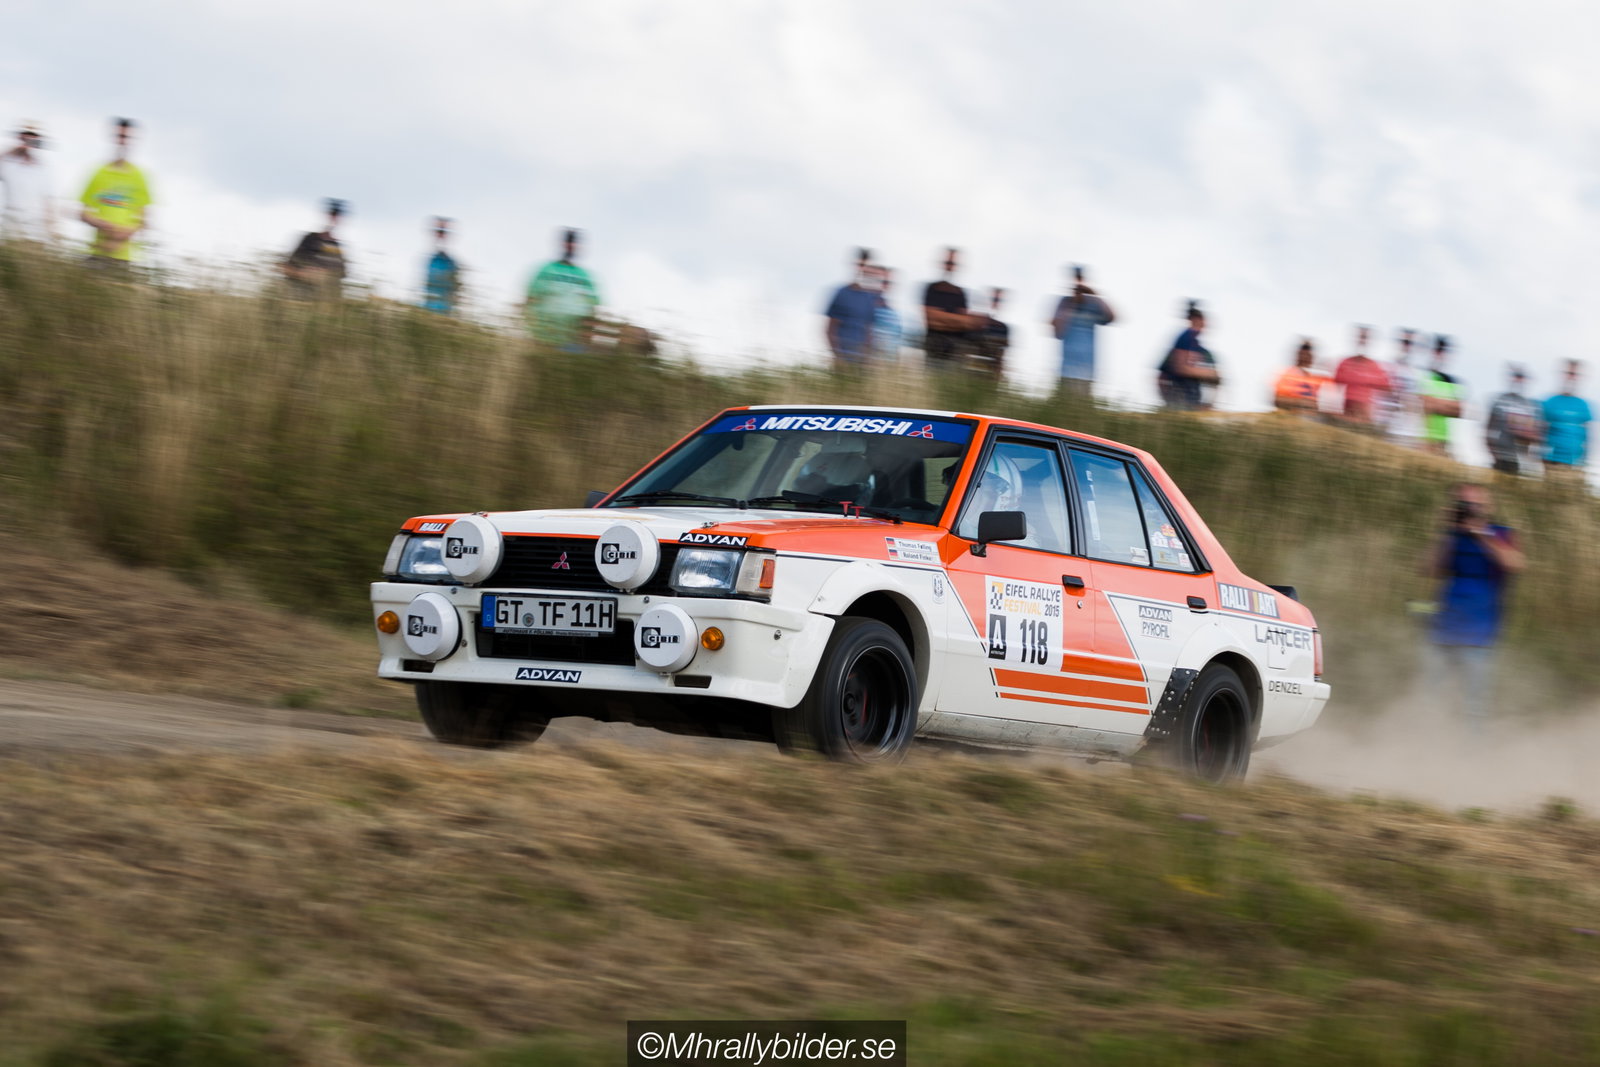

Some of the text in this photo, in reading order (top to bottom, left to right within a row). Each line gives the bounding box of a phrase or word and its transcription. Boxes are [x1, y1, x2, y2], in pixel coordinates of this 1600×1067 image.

[760, 416, 912, 436] MITSUBISHI
[680, 533, 747, 546] ADVAN
[1005, 583, 1061, 603] EIFEL RALLYE
[1219, 583, 1280, 618] RALLI ART
[495, 599, 613, 628] GT TF 11H
[1004, 598, 1060, 618] FESTIVAL 2015
[1139, 606, 1172, 621] ADVAN
[992, 619, 1004, 650] A
[1142, 621, 1170, 638] PYROFIL
[1254, 623, 1312, 651] LANCER
[1019, 618, 1049, 666] 118
[517, 668, 580, 682] ADVAN
[1268, 680, 1302, 695] DENZEL
